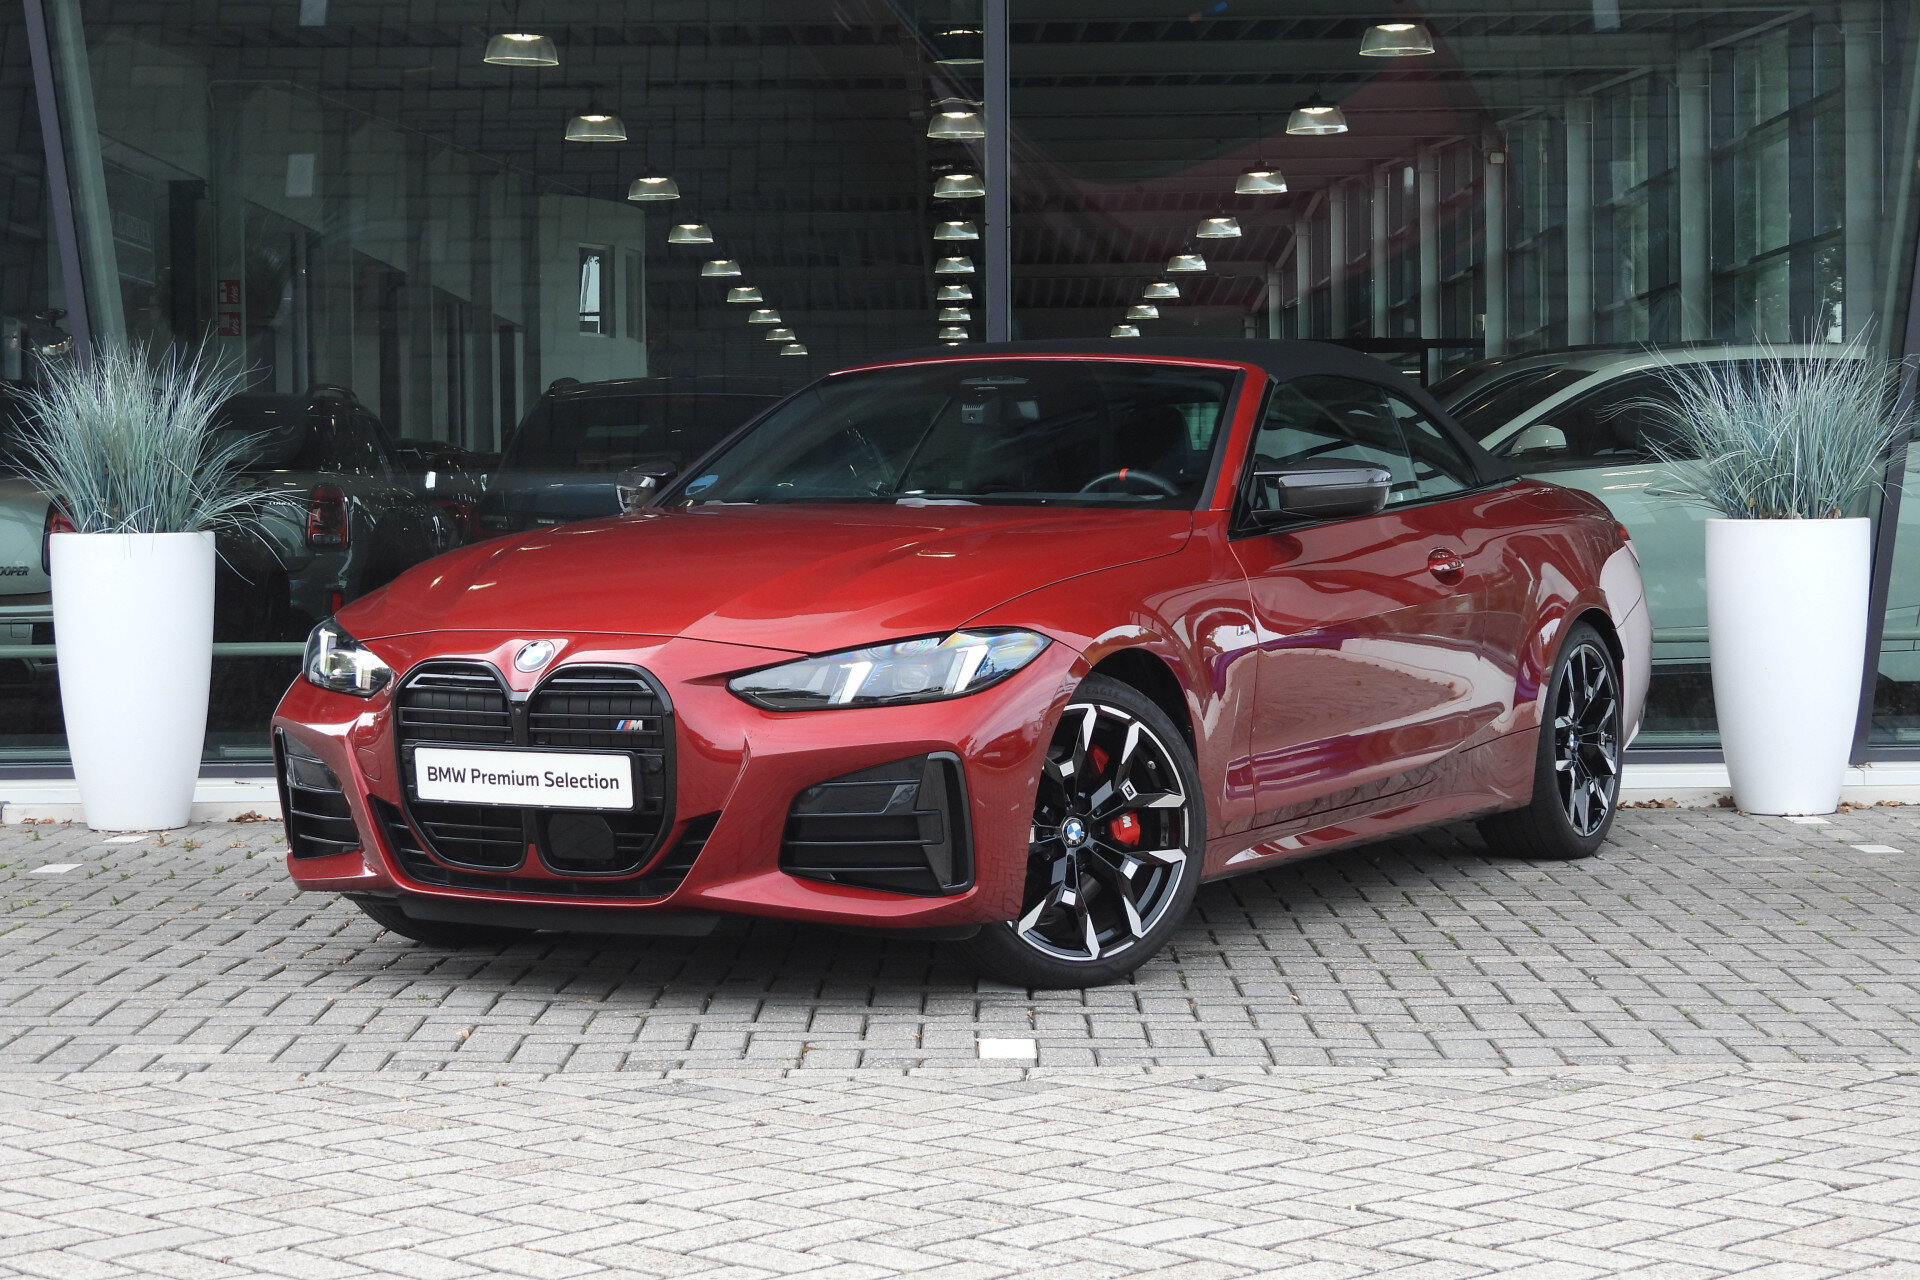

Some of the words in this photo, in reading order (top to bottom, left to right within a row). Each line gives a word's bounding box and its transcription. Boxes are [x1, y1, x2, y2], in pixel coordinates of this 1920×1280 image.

[427, 766, 466, 783] BMW
[471, 768, 539, 787] Premium
[544, 771, 620, 790] Selection
